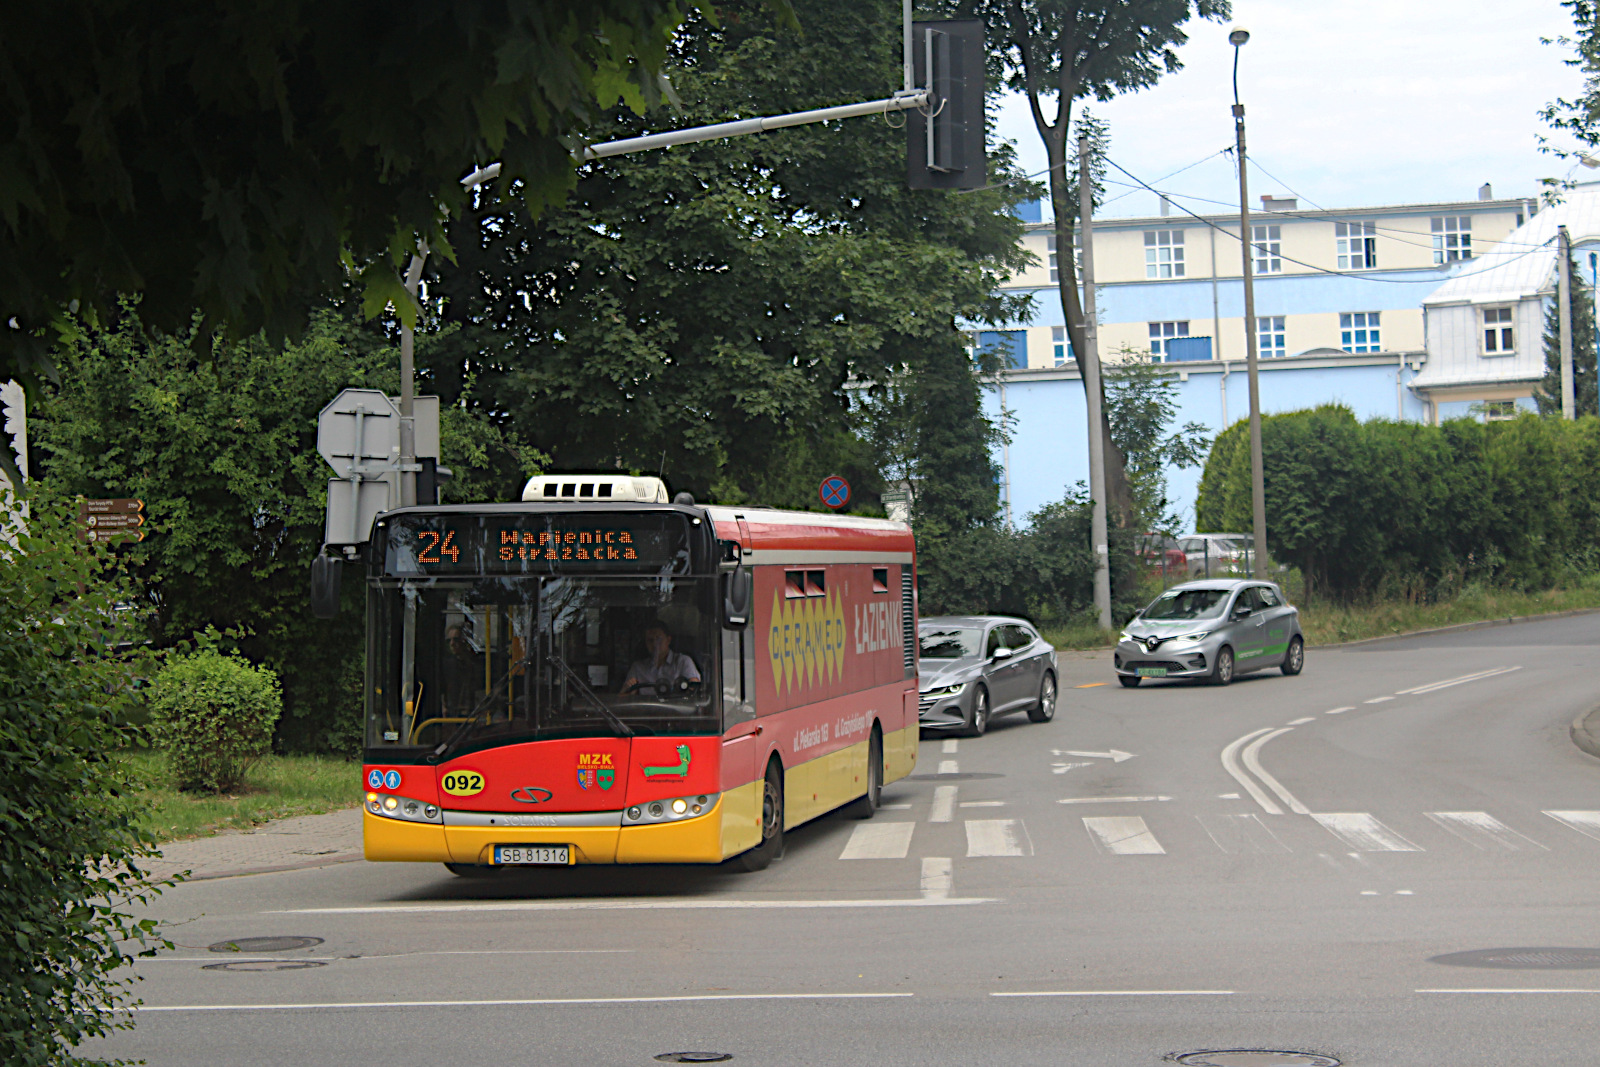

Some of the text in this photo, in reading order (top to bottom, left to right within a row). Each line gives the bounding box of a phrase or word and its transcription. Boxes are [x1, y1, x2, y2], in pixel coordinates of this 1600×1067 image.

[418, 530, 633, 563] 24 Wapienica
[499, 546, 638, 561] Strażacka
[854, 600, 903, 655] ŁAZIENKI
[772, 618, 843, 660] CERAMED
[579, 753, 612, 765] MZK
[444, 775, 482, 790] 092
[503, 816, 558, 826] SOLARIS
[503, 849, 521, 862] SB
[526, 849, 566, 862] 81316
